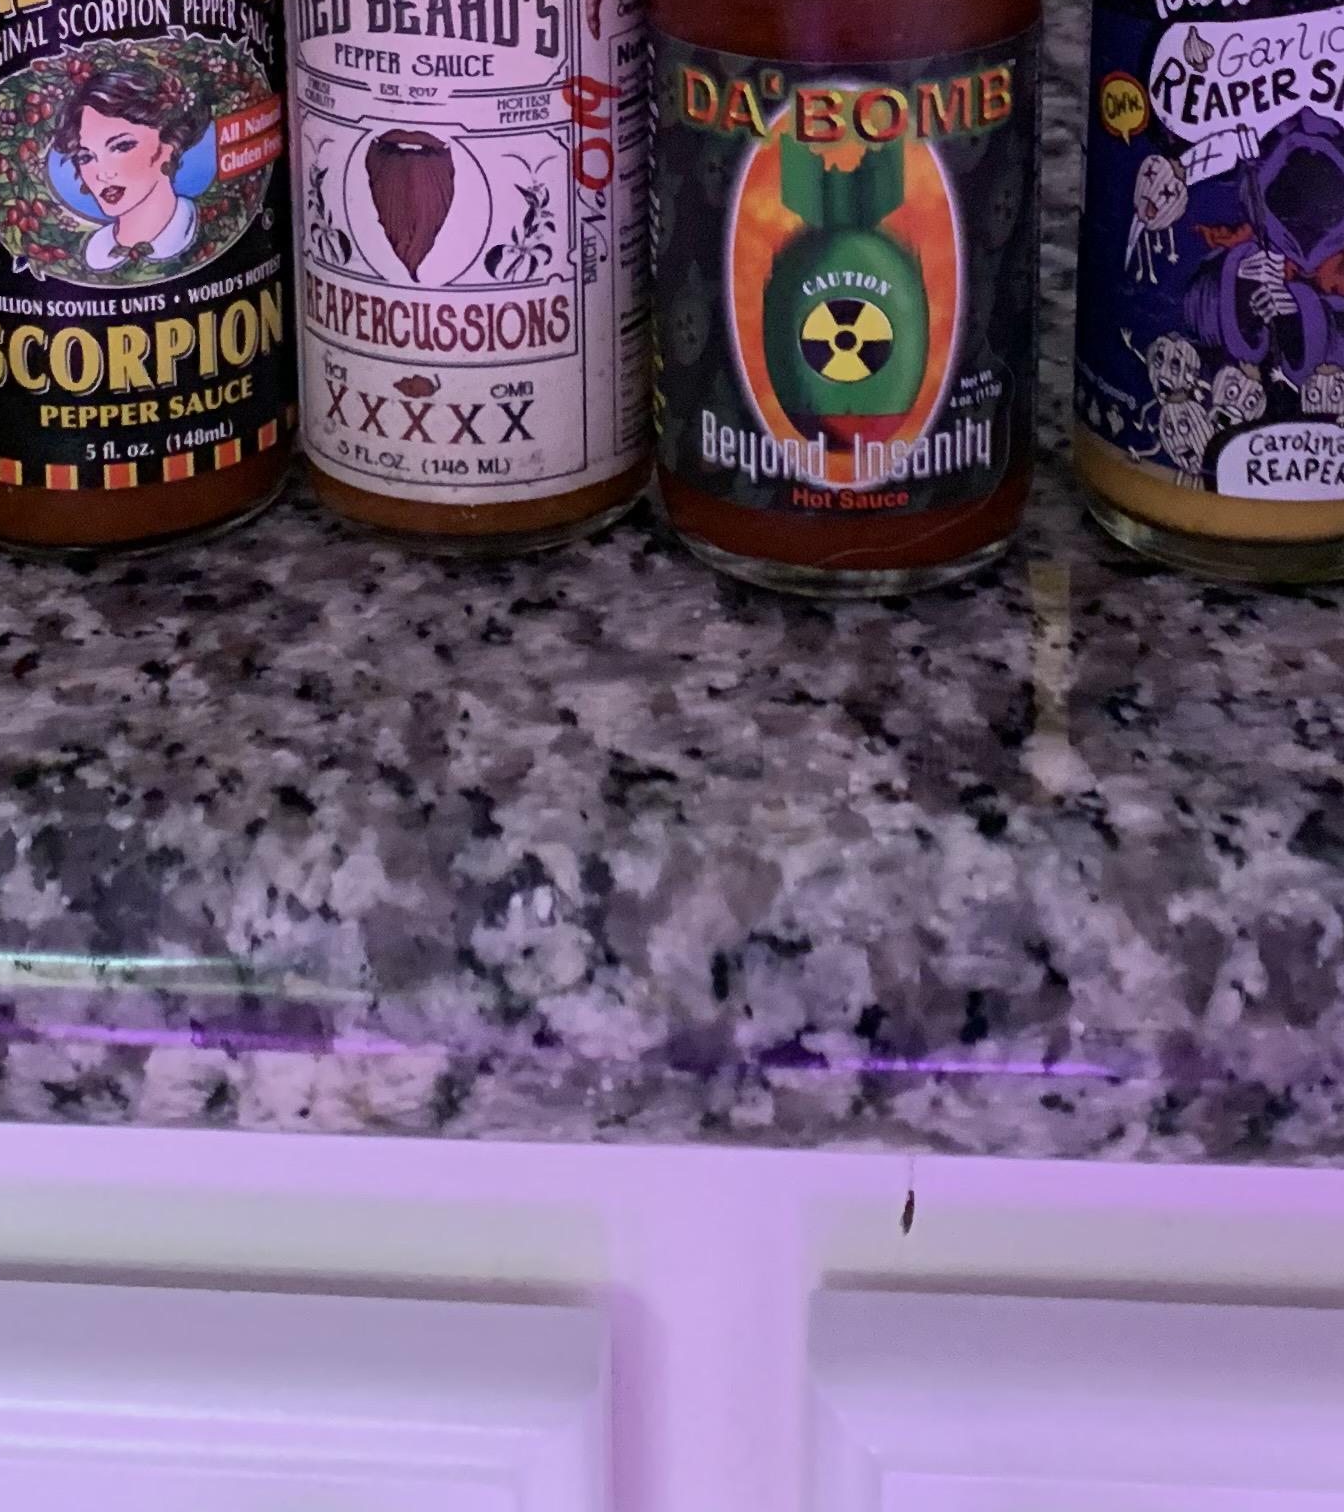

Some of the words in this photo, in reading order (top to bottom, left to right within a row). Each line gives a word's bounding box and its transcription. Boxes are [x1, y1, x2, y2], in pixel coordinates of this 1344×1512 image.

[240, 5, 274, 64] SAUCE
[335, 43, 401, 74] PEPPER
[412, 54, 495, 77] SAUCE
[497, 93, 551, 111] HOTTEST
[1151, 56, 1300, 124] REAPER
[500, 107, 550, 124] PEPPERS
[219, 120, 240, 146] All
[220, 146, 262, 173] Gluten
[582, 236, 598, 284] BATCH
[47, 299, 117, 317] SCOVILLE
[121, 293, 167, 312] UNITS
[188, 275, 244, 304] WORLD'S
[801, 269, 893, 297] CAUTION
[307, 273, 571, 352] REAPERCUSSIONS
[40, 402, 161, 429] PEPPER
[169, 375, 254, 420] SAUCE
[85, 441, 97, 461] 5
[103, 438, 122, 459] fl.
[127, 442, 155, 458] oz.
[701, 408, 826, 484] Beyond
[854, 416, 992, 481] Insanity
[792, 488, 833, 509] Hot
[840, 488, 910, 510] Sauce
